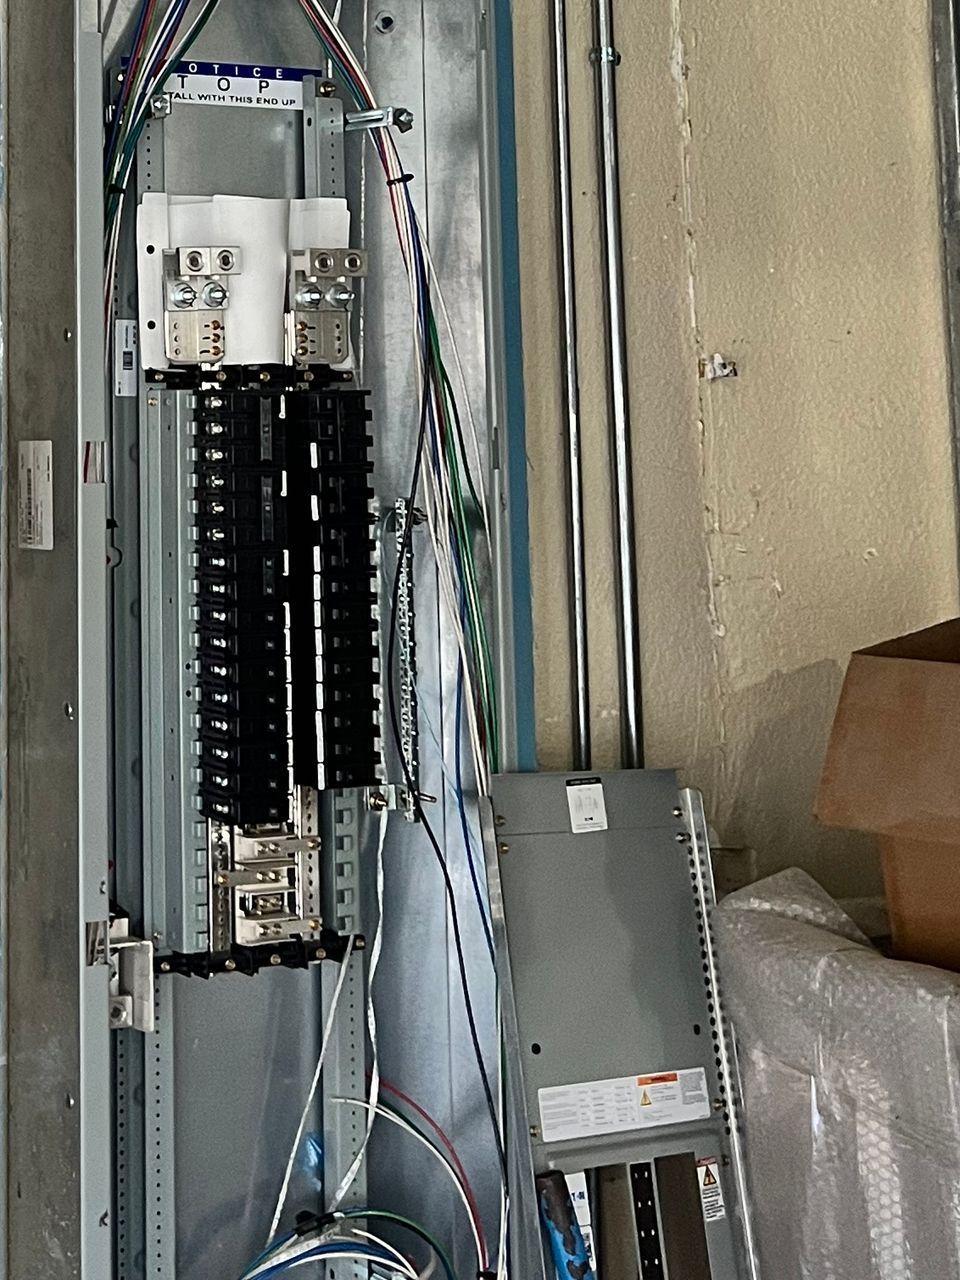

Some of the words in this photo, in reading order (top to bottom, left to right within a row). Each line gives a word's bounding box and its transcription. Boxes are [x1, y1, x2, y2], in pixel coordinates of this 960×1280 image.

[188, 63, 283, 79] OTICE
[177, 75, 270, 94] TOP
[197, 93, 226, 102] WITH
[229, 95, 253, 104] THIS
[256, 97, 278, 105] END
